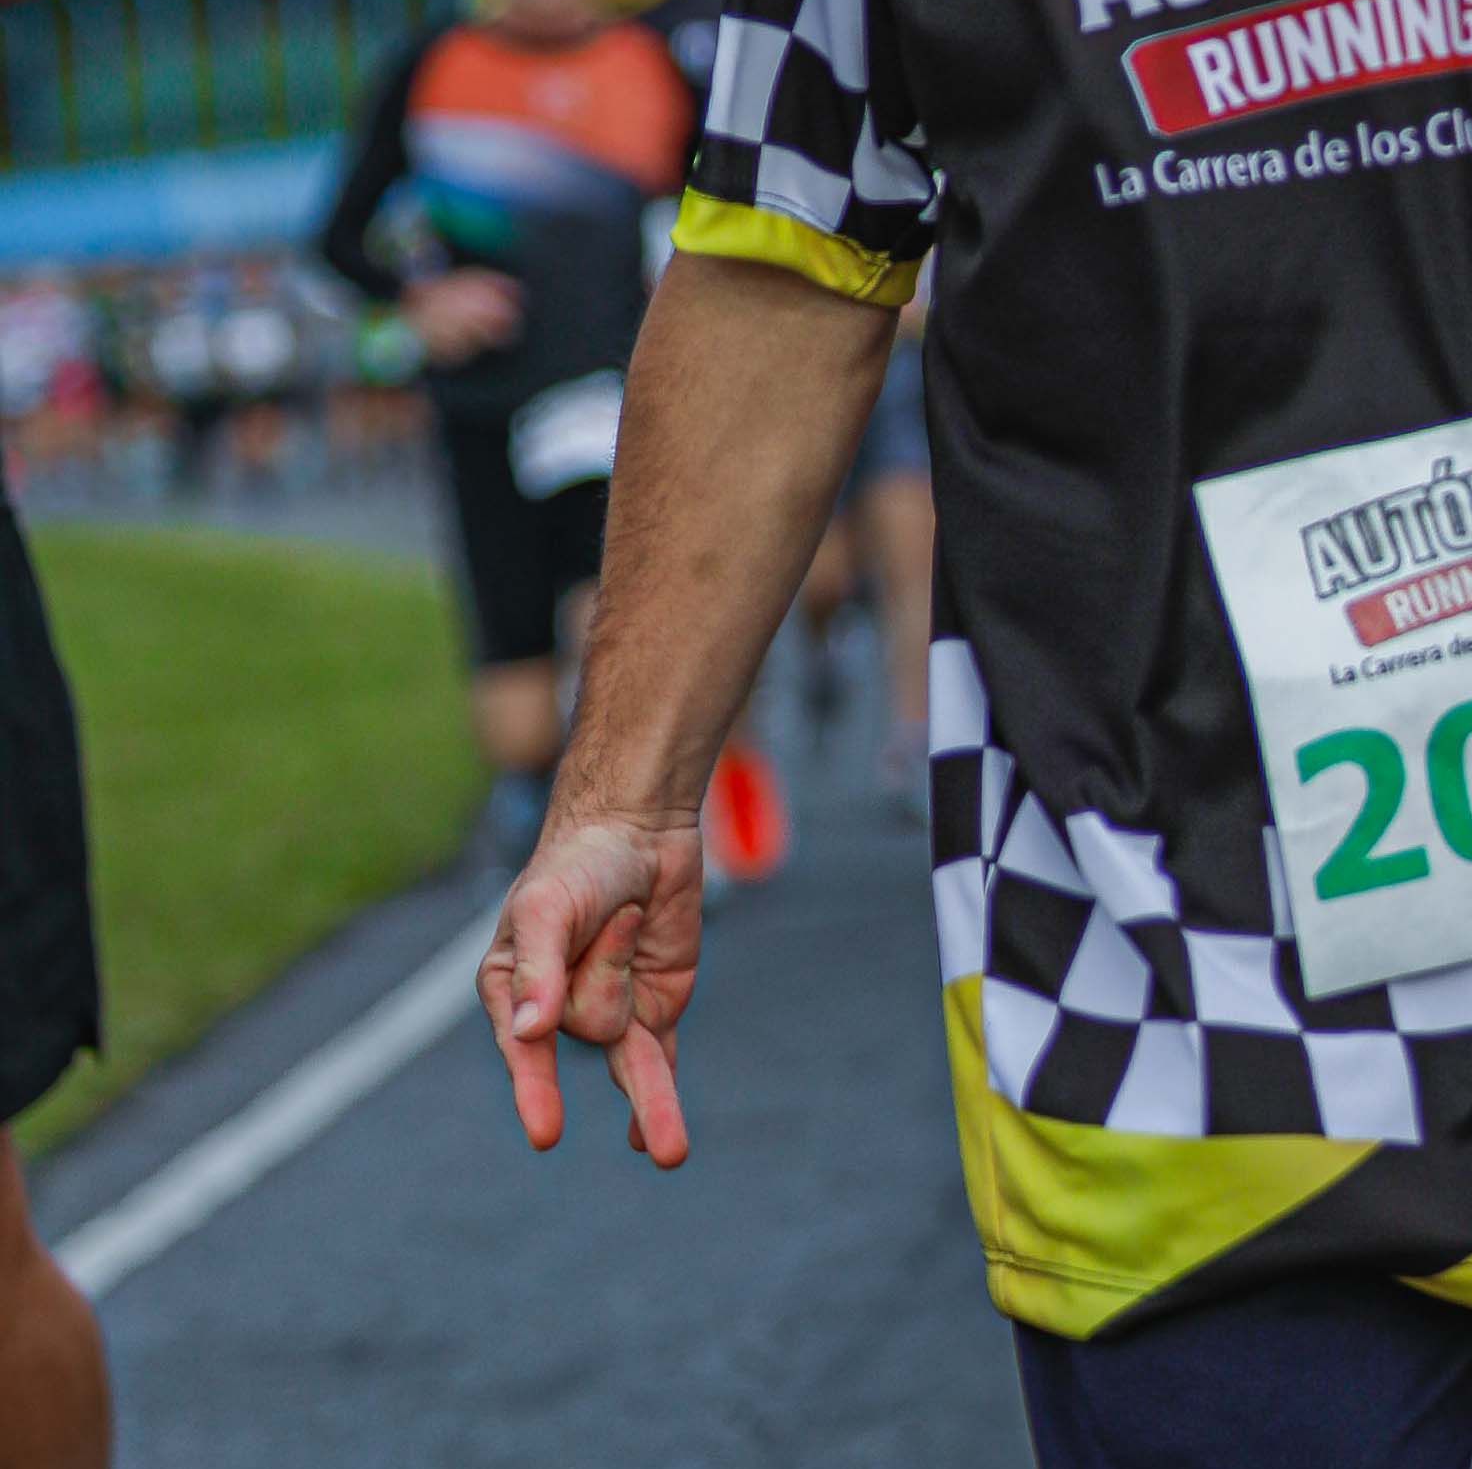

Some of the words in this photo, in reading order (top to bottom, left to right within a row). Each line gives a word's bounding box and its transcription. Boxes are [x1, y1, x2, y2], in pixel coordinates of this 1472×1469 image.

[1094, 163, 1148, 208] La
[1151, 148, 1288, 196] Carrera
[1293, 129, 1350, 179] de
[1355, 121, 1422, 169] los
[1328, 662, 1358, 686] La
[1360, 642, 1444, 678] Carrera
